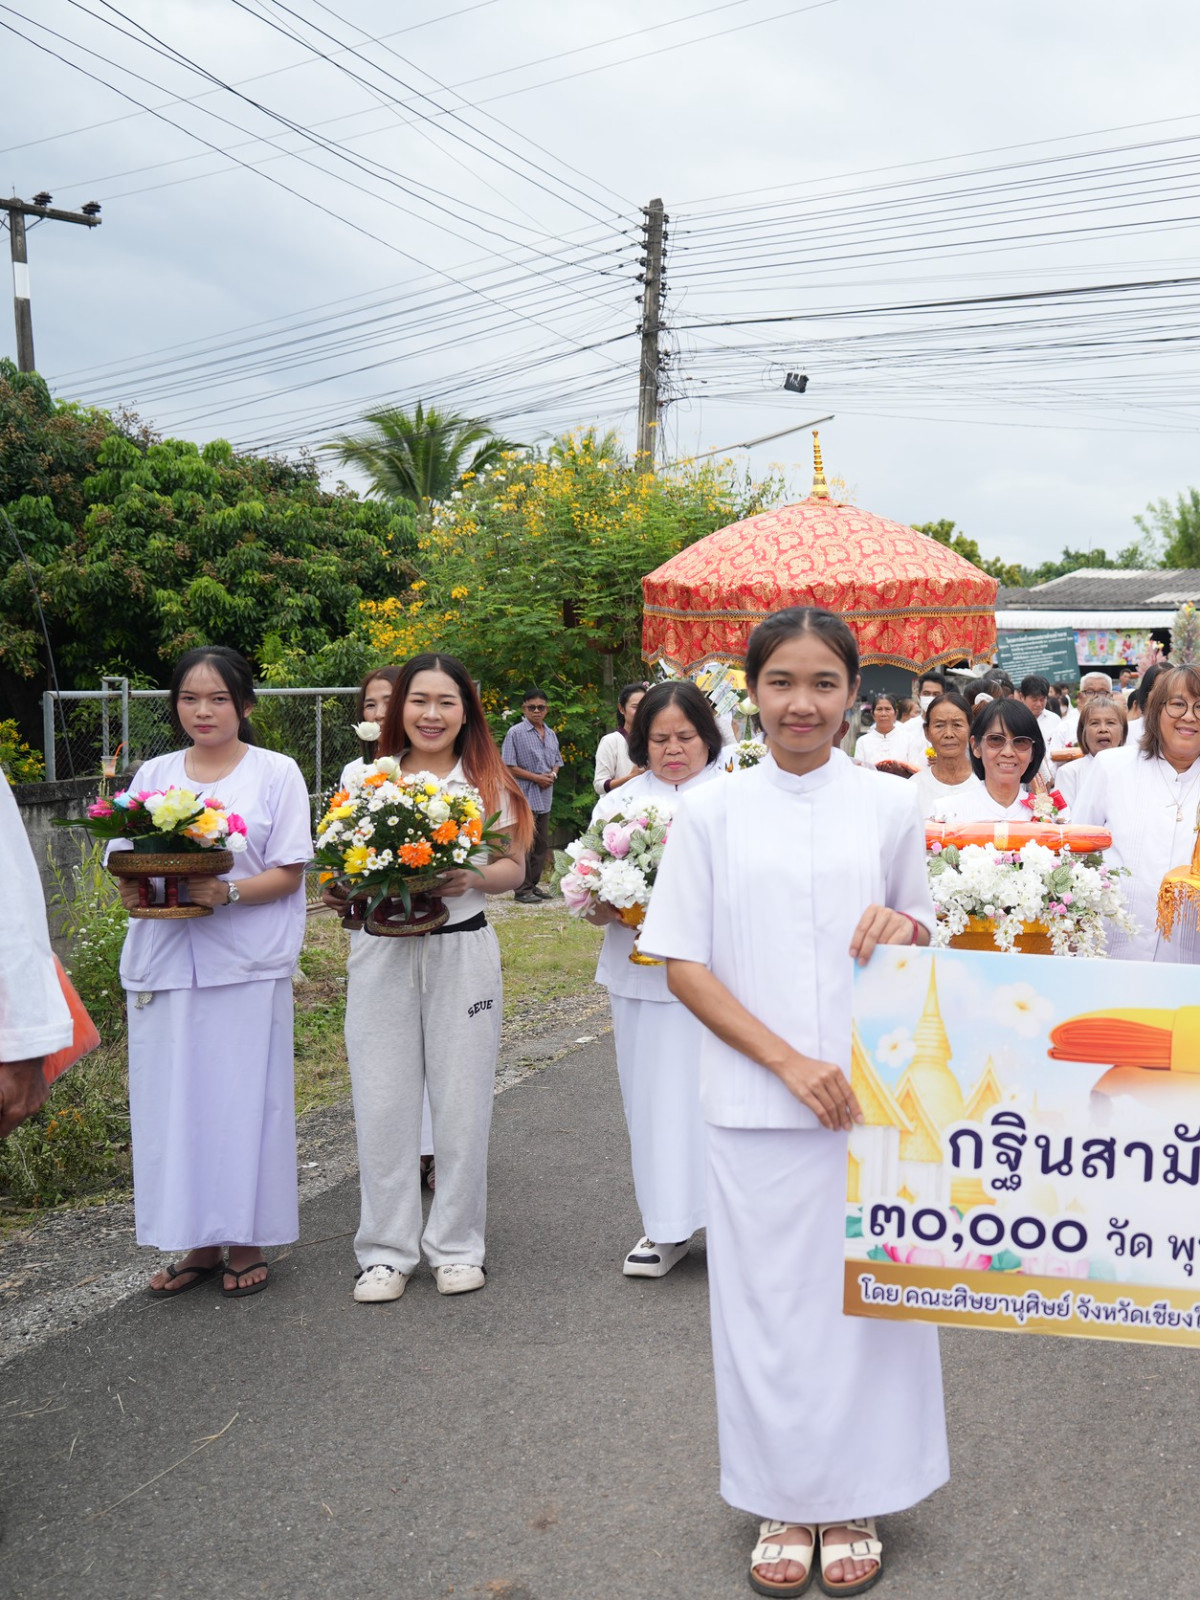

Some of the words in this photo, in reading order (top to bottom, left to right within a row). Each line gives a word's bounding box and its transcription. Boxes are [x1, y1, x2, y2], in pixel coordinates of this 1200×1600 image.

[869, 1203, 1088, 1253] ๓๐,๐๐๐
[1106, 1217, 1153, 1259] วัด
[861, 1276, 899, 1302] โดย
[906, 1286, 1070, 1322] คณะศิษยานุศิษย์
